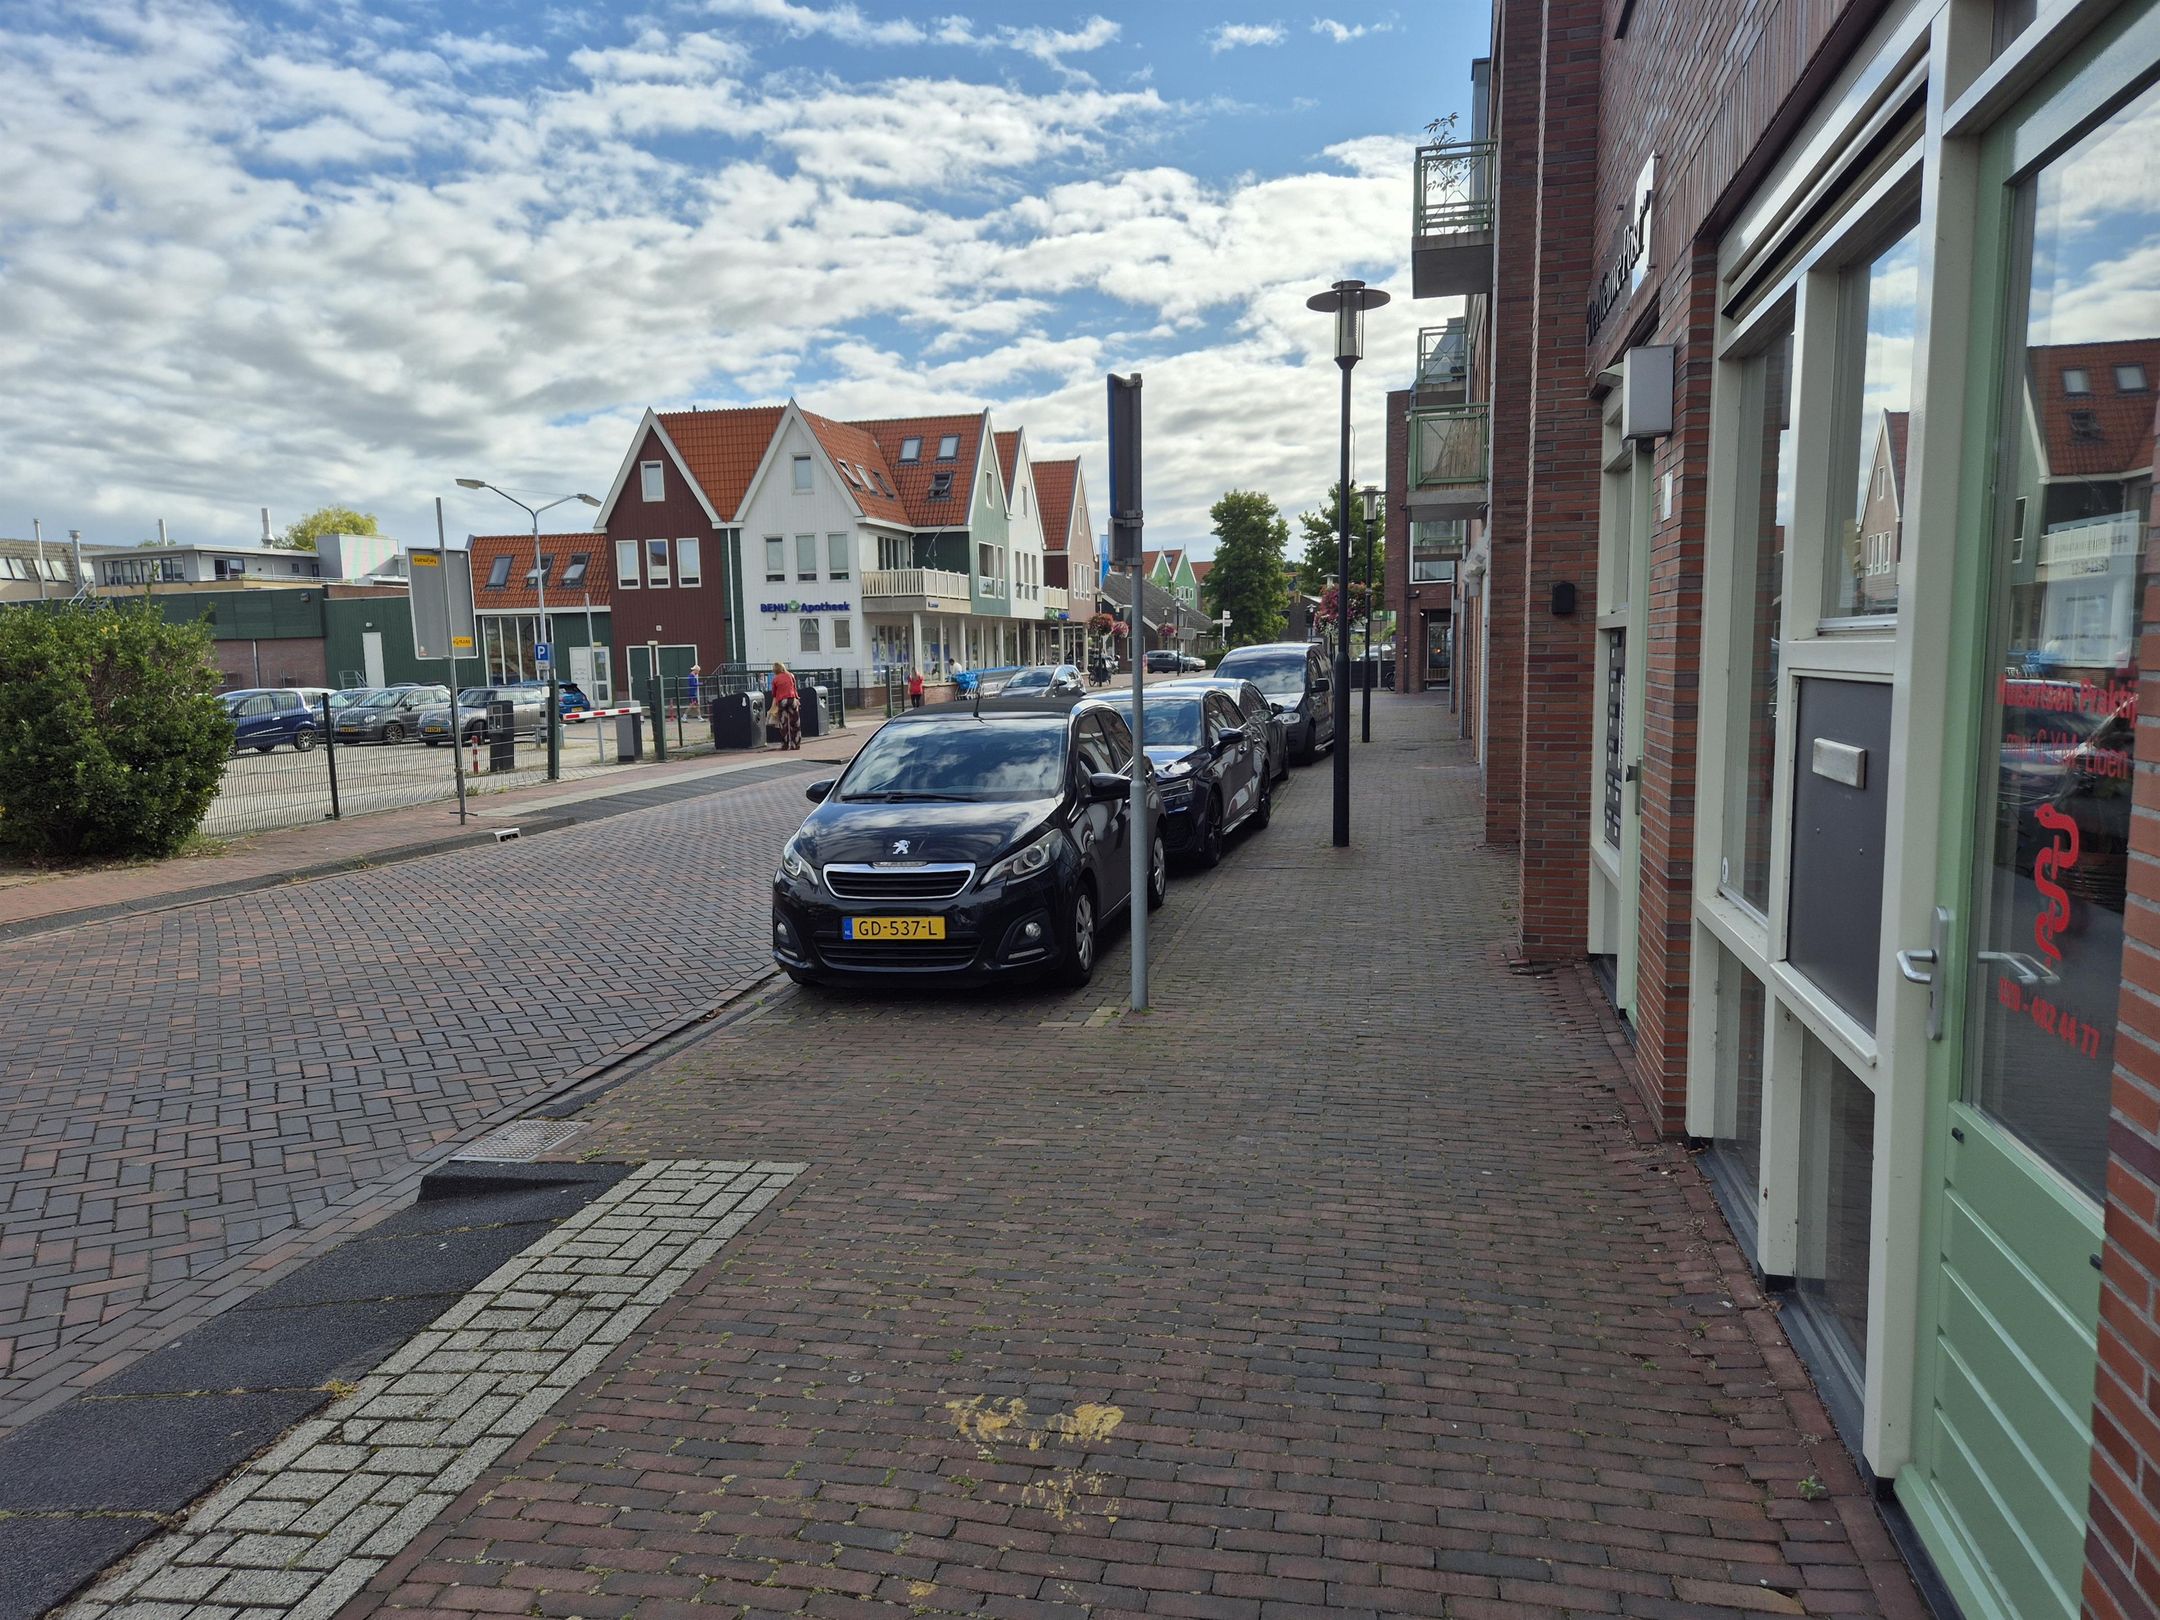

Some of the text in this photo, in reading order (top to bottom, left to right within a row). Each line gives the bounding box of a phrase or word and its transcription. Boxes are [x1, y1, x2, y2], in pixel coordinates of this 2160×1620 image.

[761, 601, 850, 614] BENU Apotheek
[537, 645, 546, 659] P
[2080, 678, 2138, 729] Praktij
[859, 921, 938, 936] GD-537-L
